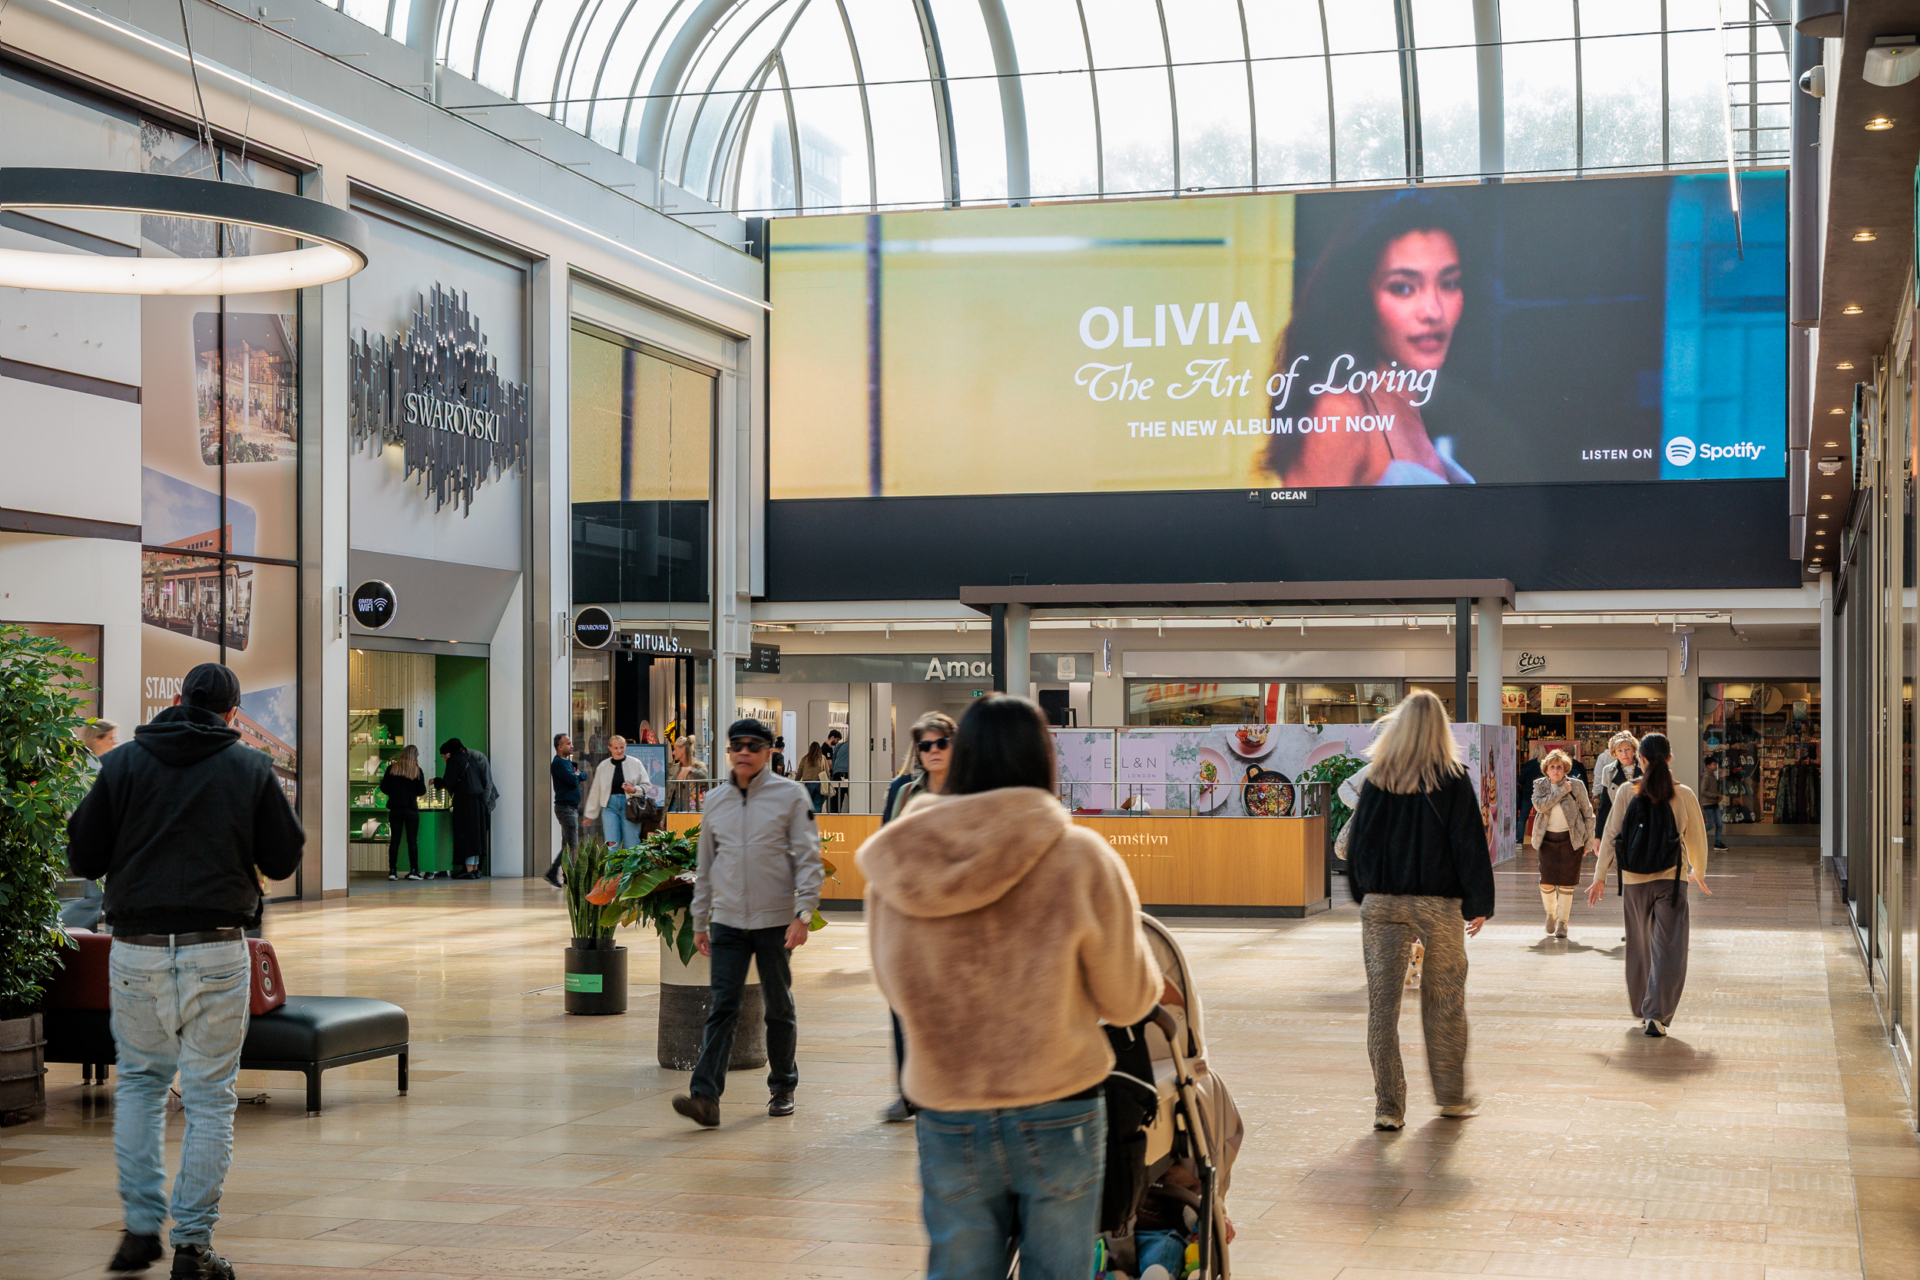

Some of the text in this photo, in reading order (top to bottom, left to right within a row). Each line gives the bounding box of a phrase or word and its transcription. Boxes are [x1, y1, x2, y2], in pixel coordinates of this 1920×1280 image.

[1079, 301, 1262, 350] OLIVIA
[1074, 353, 1438, 411] The Art of Loving
[404, 392, 500, 443] SWAROVSKI
[1127, 414, 1396, 438] THE NEW ALBUM OUT NOW
[1582, 448, 1653, 460] LISTEN ON
[1699, 441, 1762, 461] Spotify
[1271, 490, 1307, 500] OCEAN
[1519, 652, 1546, 668] Etos
[145, 677, 184, 699] STADS
